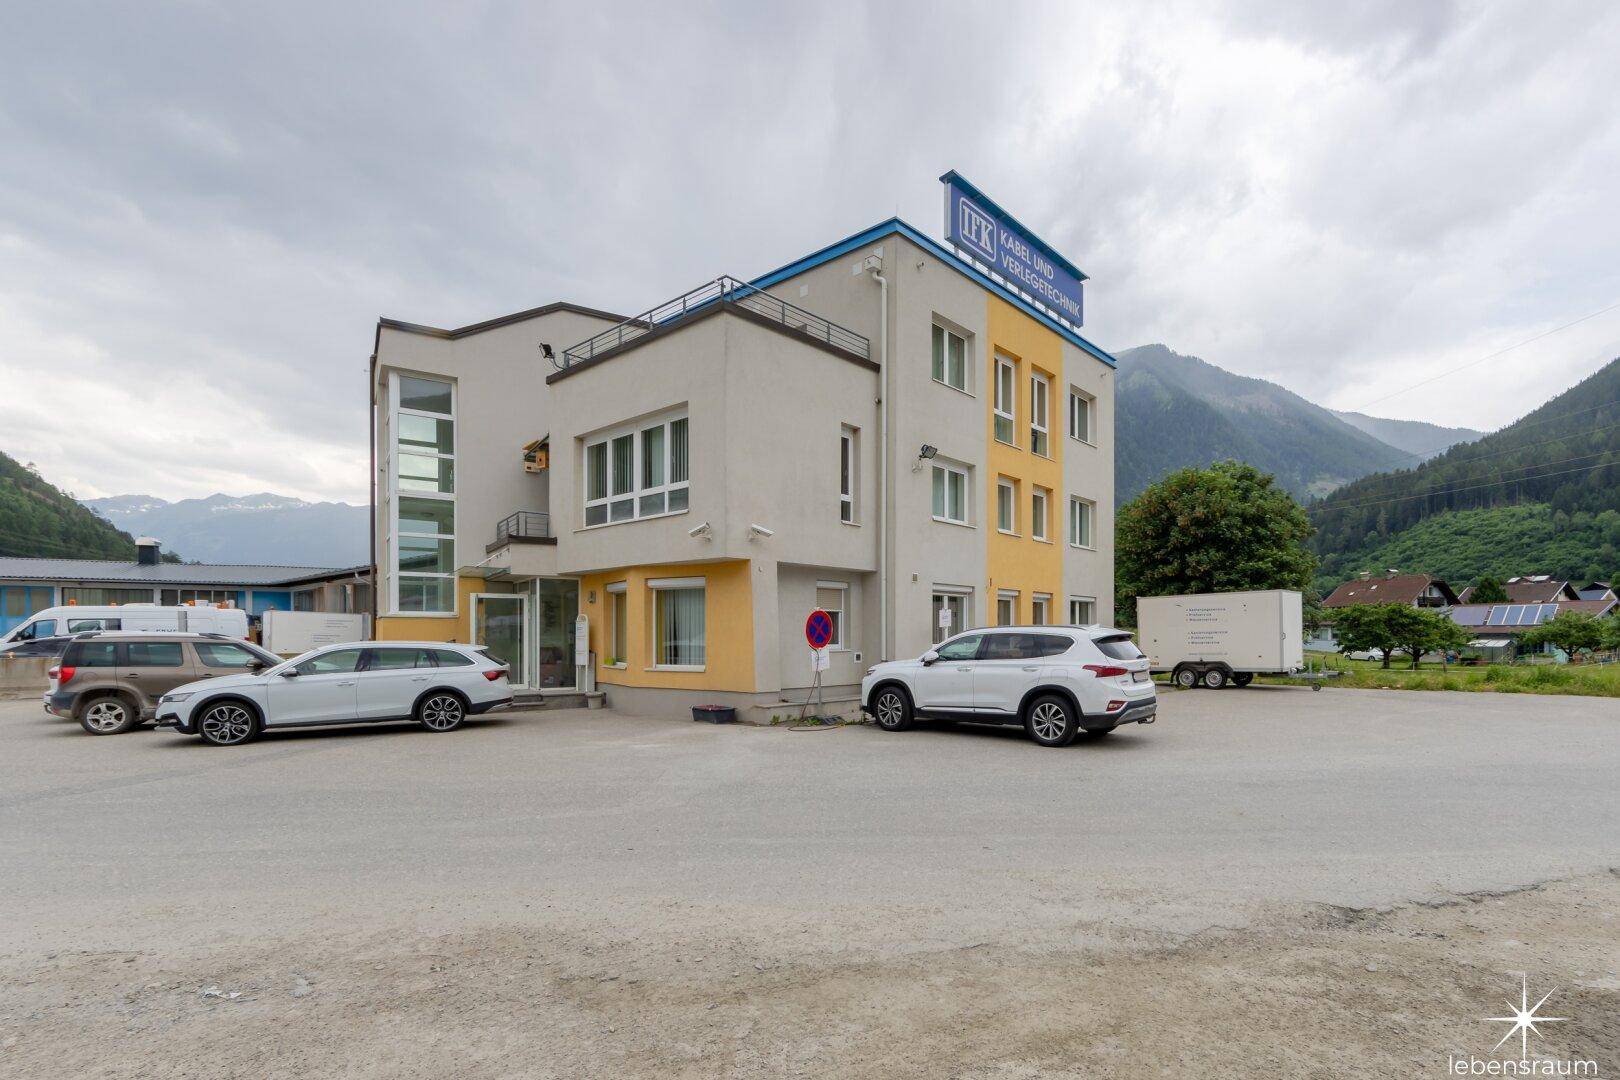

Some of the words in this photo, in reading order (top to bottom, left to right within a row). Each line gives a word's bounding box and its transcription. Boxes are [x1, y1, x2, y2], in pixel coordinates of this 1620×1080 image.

[962, 205, 993, 254] IFK
[1000, 229, 1031, 265] KABEL
[1033, 254, 1054, 280] UND
[1000, 251, 1080, 318] VERLEGETECHNIK
